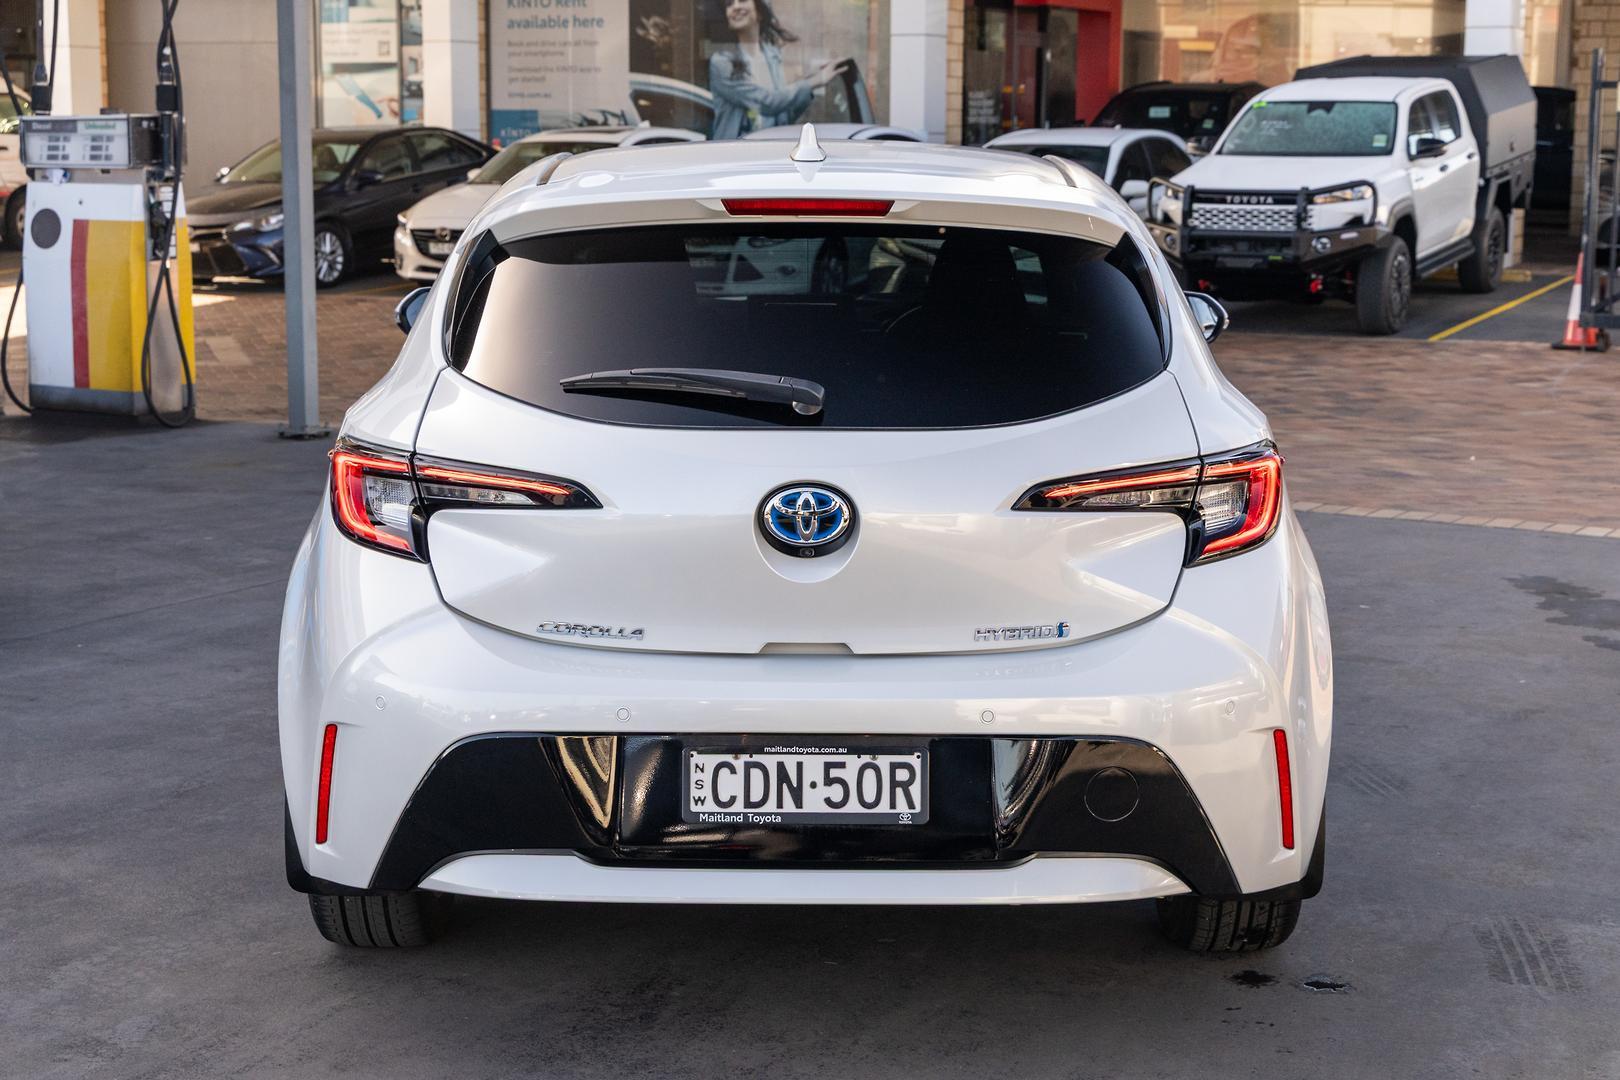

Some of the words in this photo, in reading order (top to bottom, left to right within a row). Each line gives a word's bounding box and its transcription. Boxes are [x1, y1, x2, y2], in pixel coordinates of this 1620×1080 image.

[507, 0, 551, 8] KINTO
[555, 0, 588, 8] Rent
[507, 15, 569, 30] available
[573, 15, 605, 29] here
[1225, 195, 1275, 204] TOYOTA
[536, 620, 644, 641] COROLLA
[974, 625, 1057, 641] HYBRID
[764, 746, 848, 754] maitlandtoyota.com.au
[699, 813, 743, 823] Maitland
[747, 814, 782, 824] Toyota
